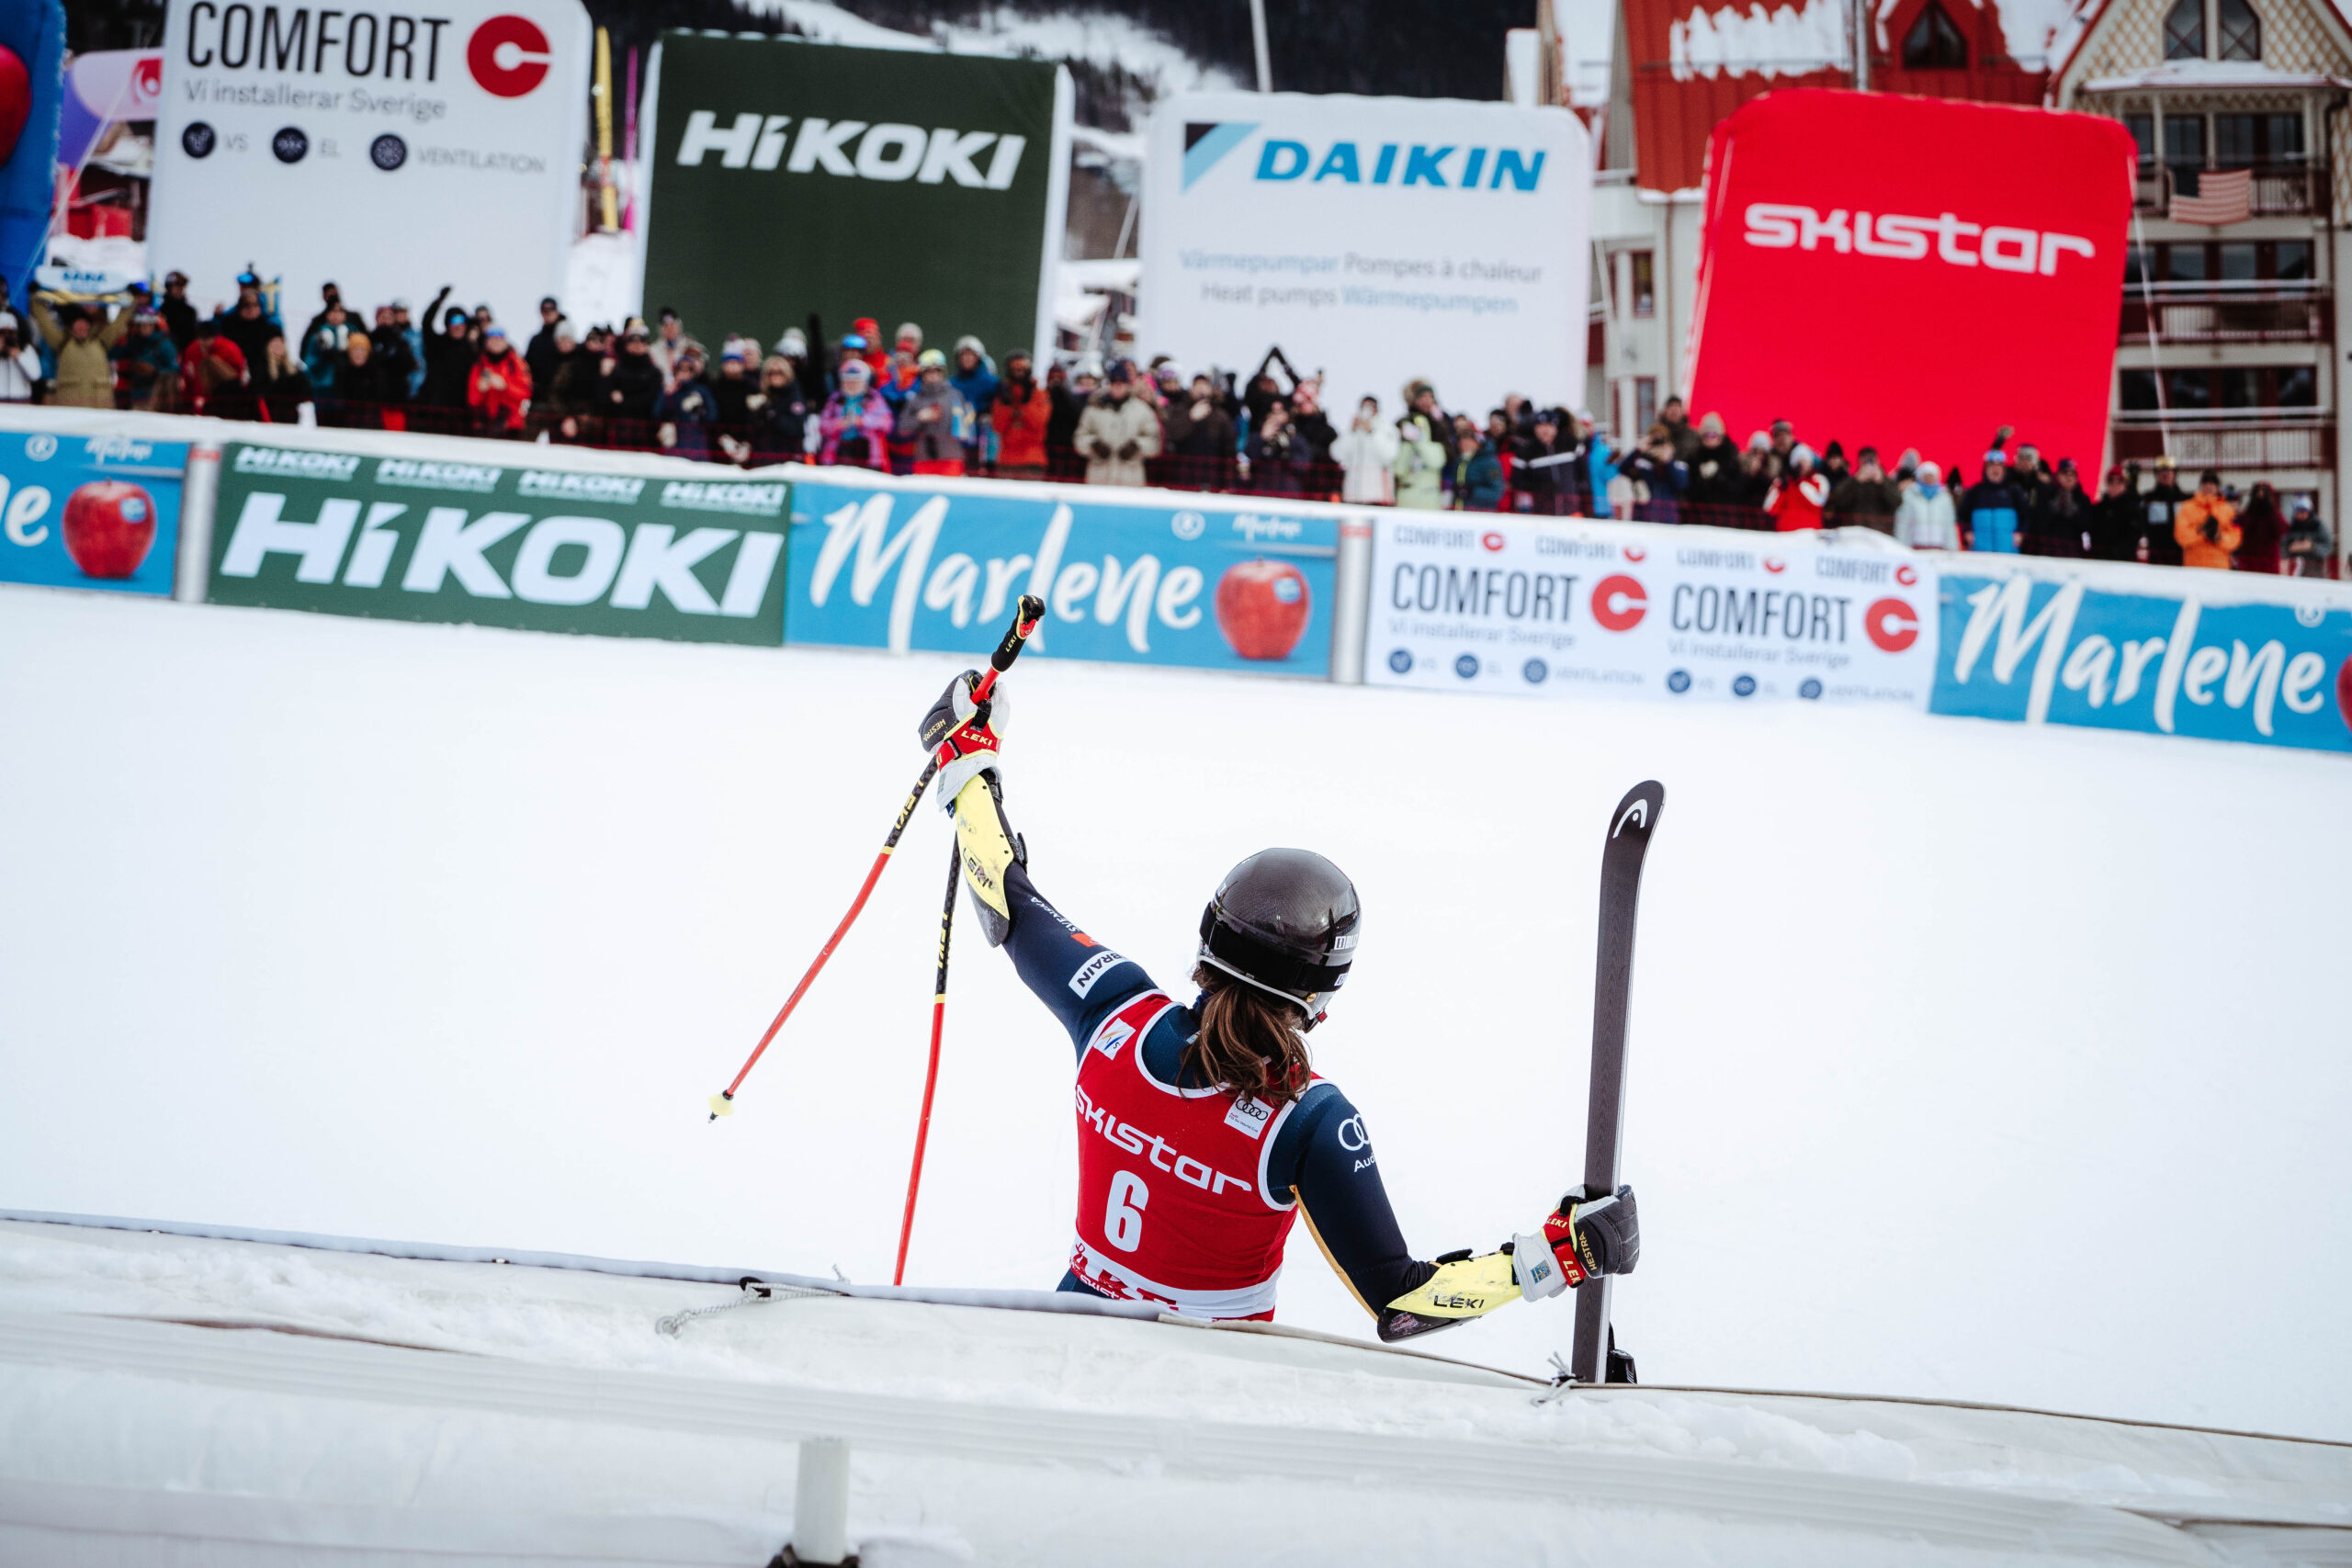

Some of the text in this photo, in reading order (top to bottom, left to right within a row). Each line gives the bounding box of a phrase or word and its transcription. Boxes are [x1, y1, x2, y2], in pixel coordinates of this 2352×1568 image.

[187, 1, 452, 82] COMFORT
[185, 79, 447, 122] Vi installerar Sverige
[224, 136, 249, 152] VS
[319, 140, 341, 158] EL
[417, 147, 547, 173] VENTILATION
[1254, 140, 1547, 192] DAIKIN
[1342, 252, 1434, 279] Pompes
[1459, 259, 1542, 284] chaleur
[1201, 283, 1253, 304] Heat
[1258, 287, 1338, 308] pumps
[809, 492, 1205, 655] Marlene
[1392, 562, 1579, 623] COMFORT
[1671, 584, 1852, 643] COMFORT
[1005, 635, 1017, 652] LEKI
[1412, 620, 1504, 643] installerar
[1507, 627, 1577, 650] Sverige
[1691, 640, 1780, 662] installerar
[1785, 646, 1850, 669] Sverige
[1953, 575, 2326, 737] Marlene
[923, 718, 946, 741] HESTRA
[961, 730, 993, 747] LEKI
[1354, 1153, 1375, 1173] Aud
[1104, 1169, 1149, 1253] 6
[1546, 1218, 1567, 1228] LEKI
[1578, 1231, 1598, 1271] HESTRA
[1563, 1260, 1581, 1285] LEK
[1433, 1295, 1485, 1308] LEKI
